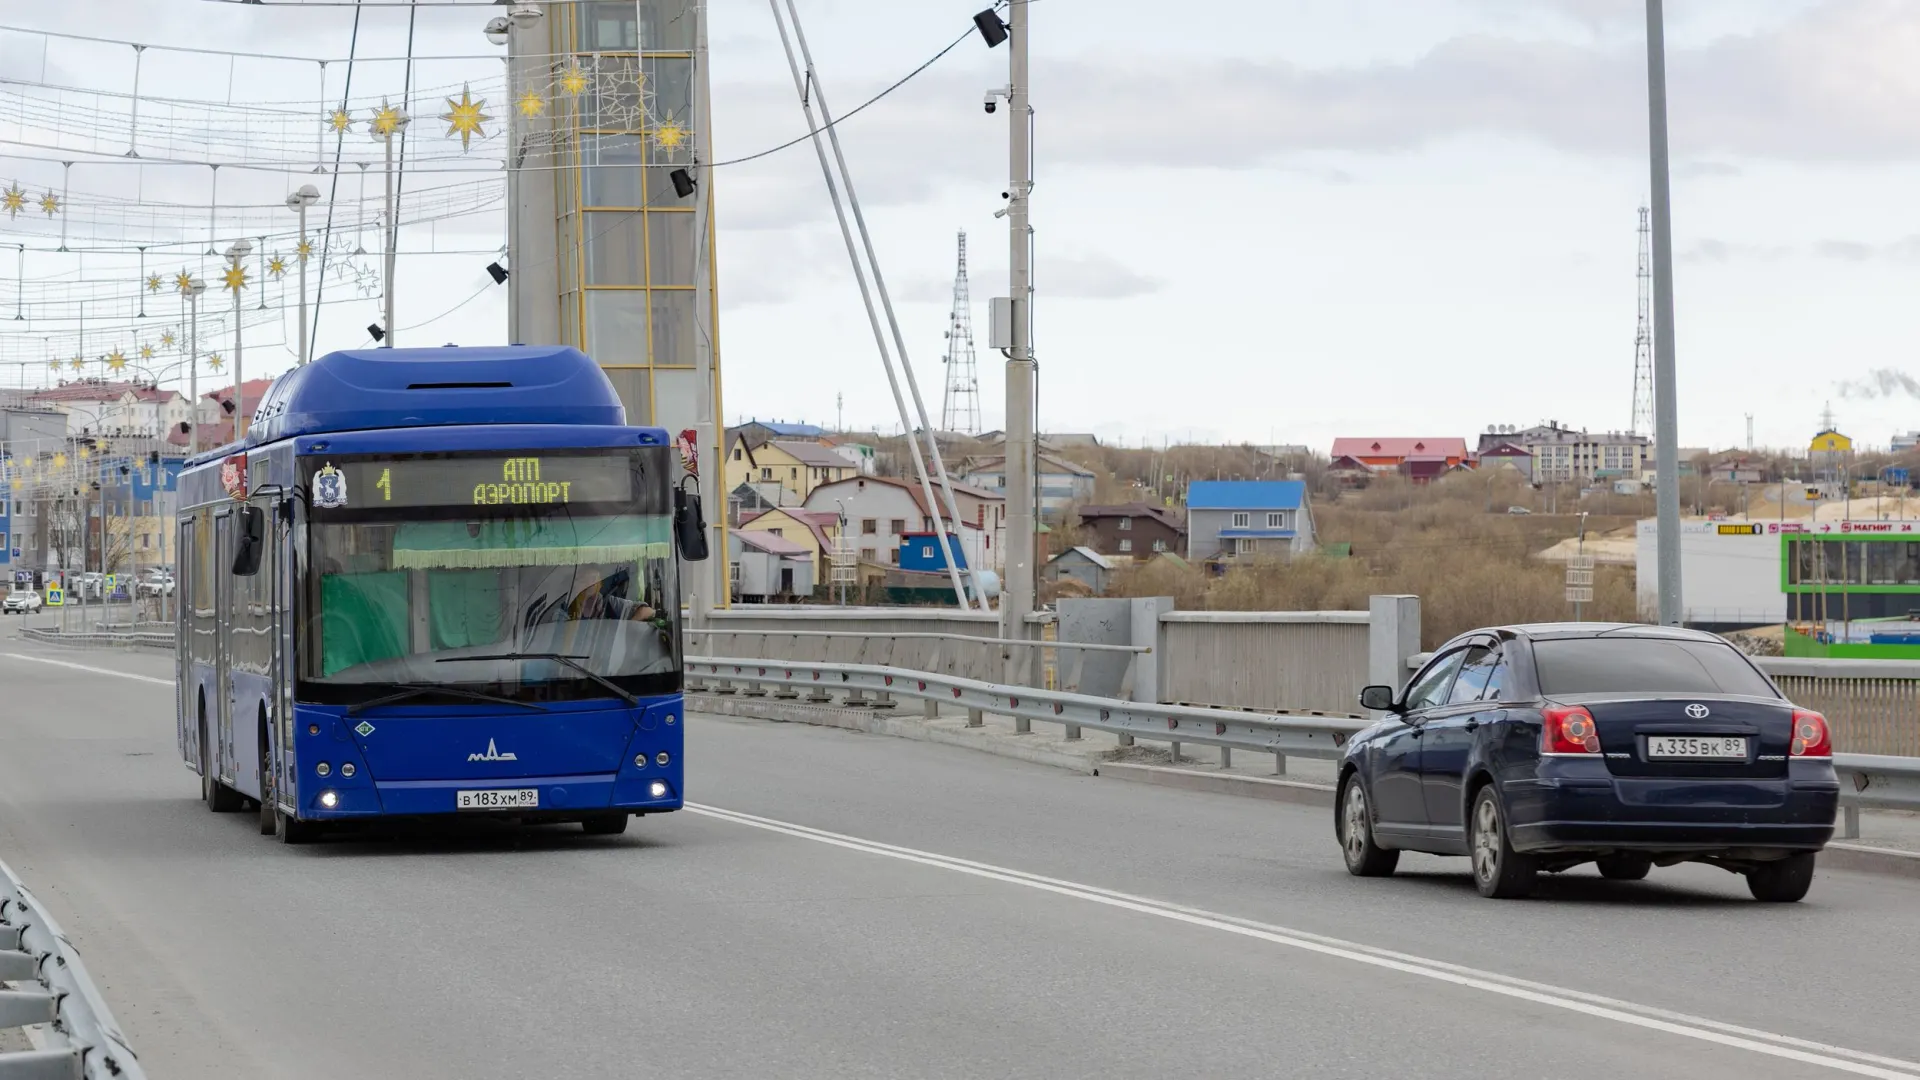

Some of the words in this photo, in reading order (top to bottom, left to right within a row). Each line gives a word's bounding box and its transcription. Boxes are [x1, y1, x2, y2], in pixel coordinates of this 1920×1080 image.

[503, 457, 540, 481] АТП
[376, 468, 391, 501] 1
[473, 481, 571, 505] АЭРОПОРТ
[1853, 524, 1893, 532] МАГНИТ
[1901, 524, 1912, 532] 24
